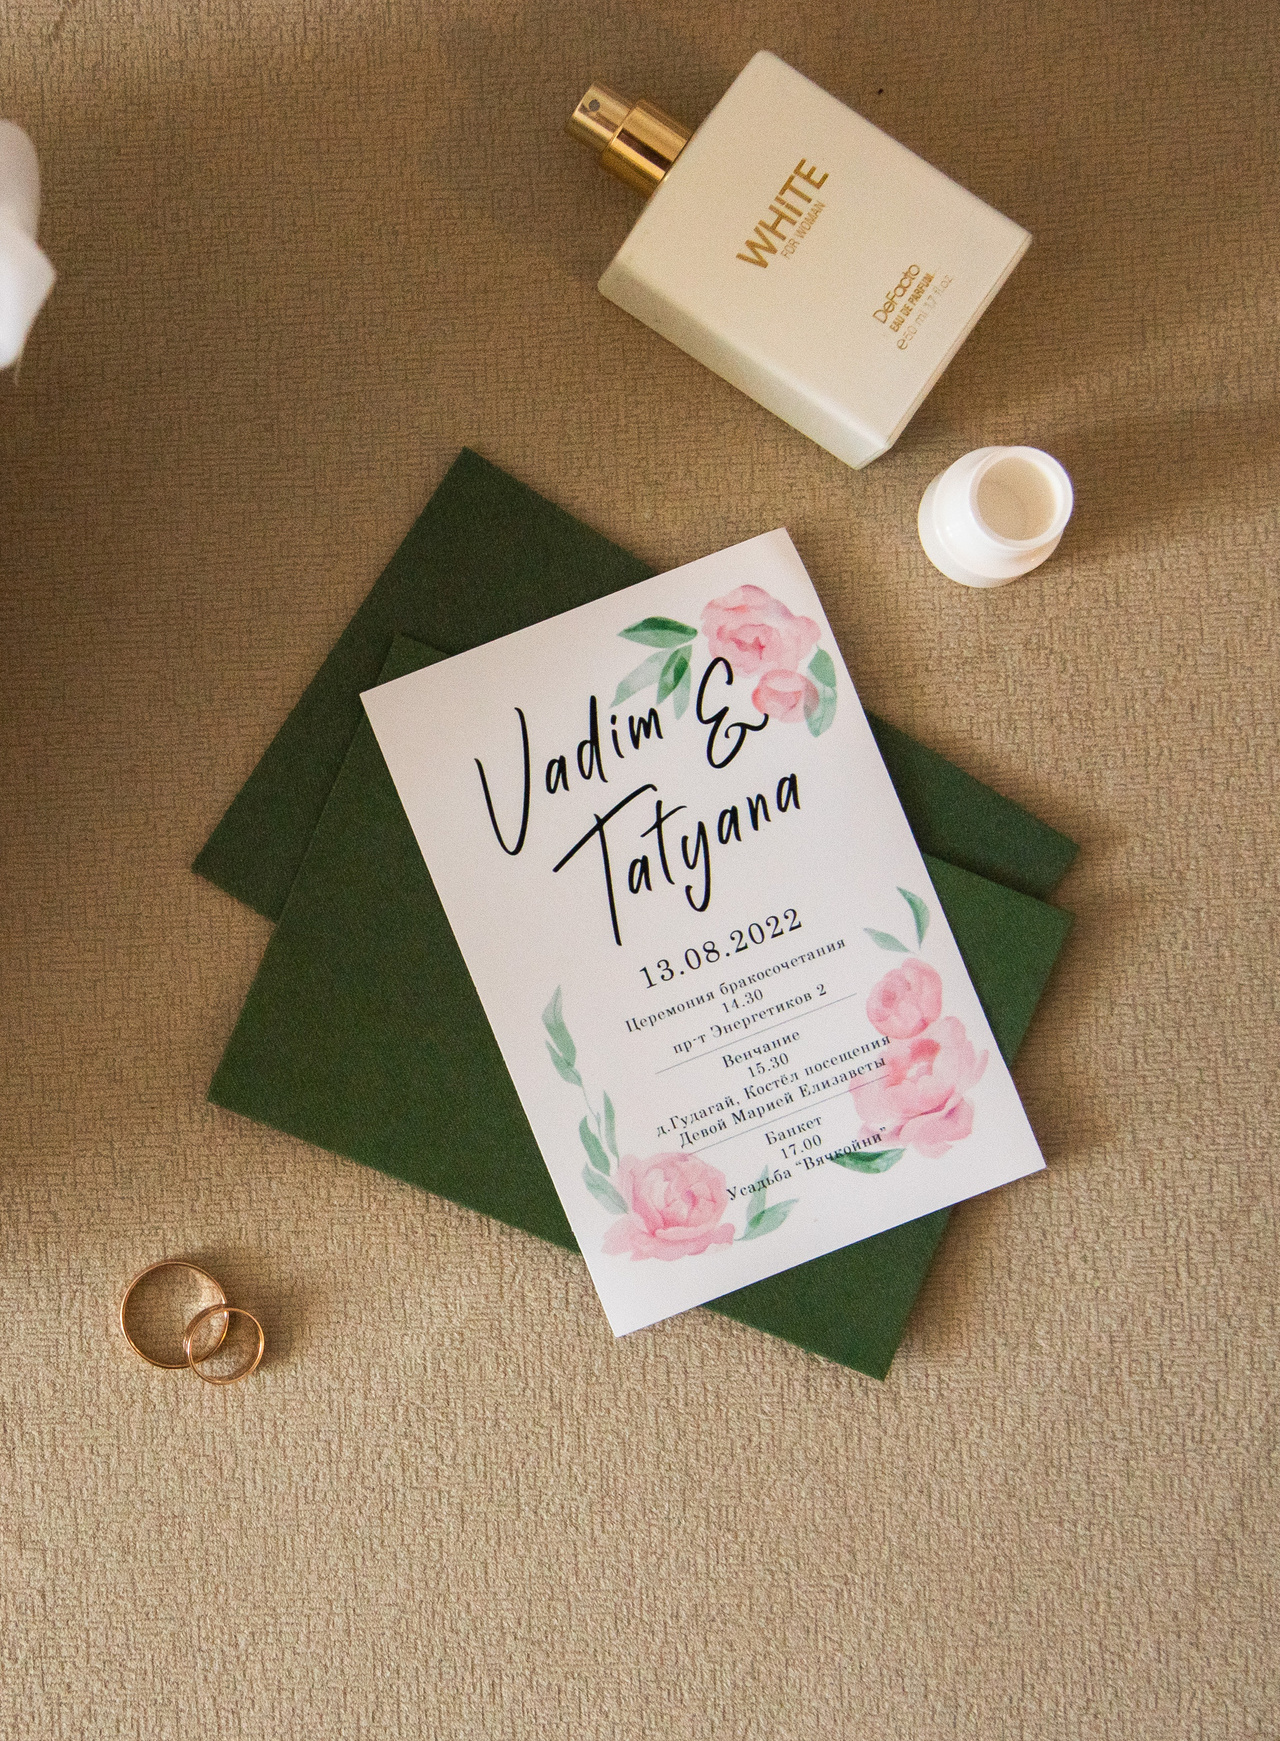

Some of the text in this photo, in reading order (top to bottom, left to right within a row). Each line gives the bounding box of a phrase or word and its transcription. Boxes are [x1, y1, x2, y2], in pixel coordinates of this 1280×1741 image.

[735, 158, 829, 268] WHITE
[781, 200, 826, 260] FOR WOMAN
[872, 264, 920, 324] DeFacto
[889, 272, 935, 333] EAU DE PARFUM
[474, 656, 768, 856] Vadim &
[552, 773, 801, 946] Tatyana
[639, 908, 802, 989] 13.08.2022
[624, 938, 846, 1033] Церемония бракосочетания
[721, 988, 764, 1014] 14.30
[673, 983, 827, 1056] пр-т Энергетиков 2
[722, 1030, 801, 1068] Венчание
[656, 1036, 891, 1137] д.Гудагай, Костёл посещения
[747, 1053, 790, 1079] 15.30
[679, 1056, 886, 1149] Девой Марией Елизаветы
[764, 1115, 823, 1146] Банкет
[780, 1134, 822, 1160] 17.00
[726, 1169, 792, 1200] Усадьба
